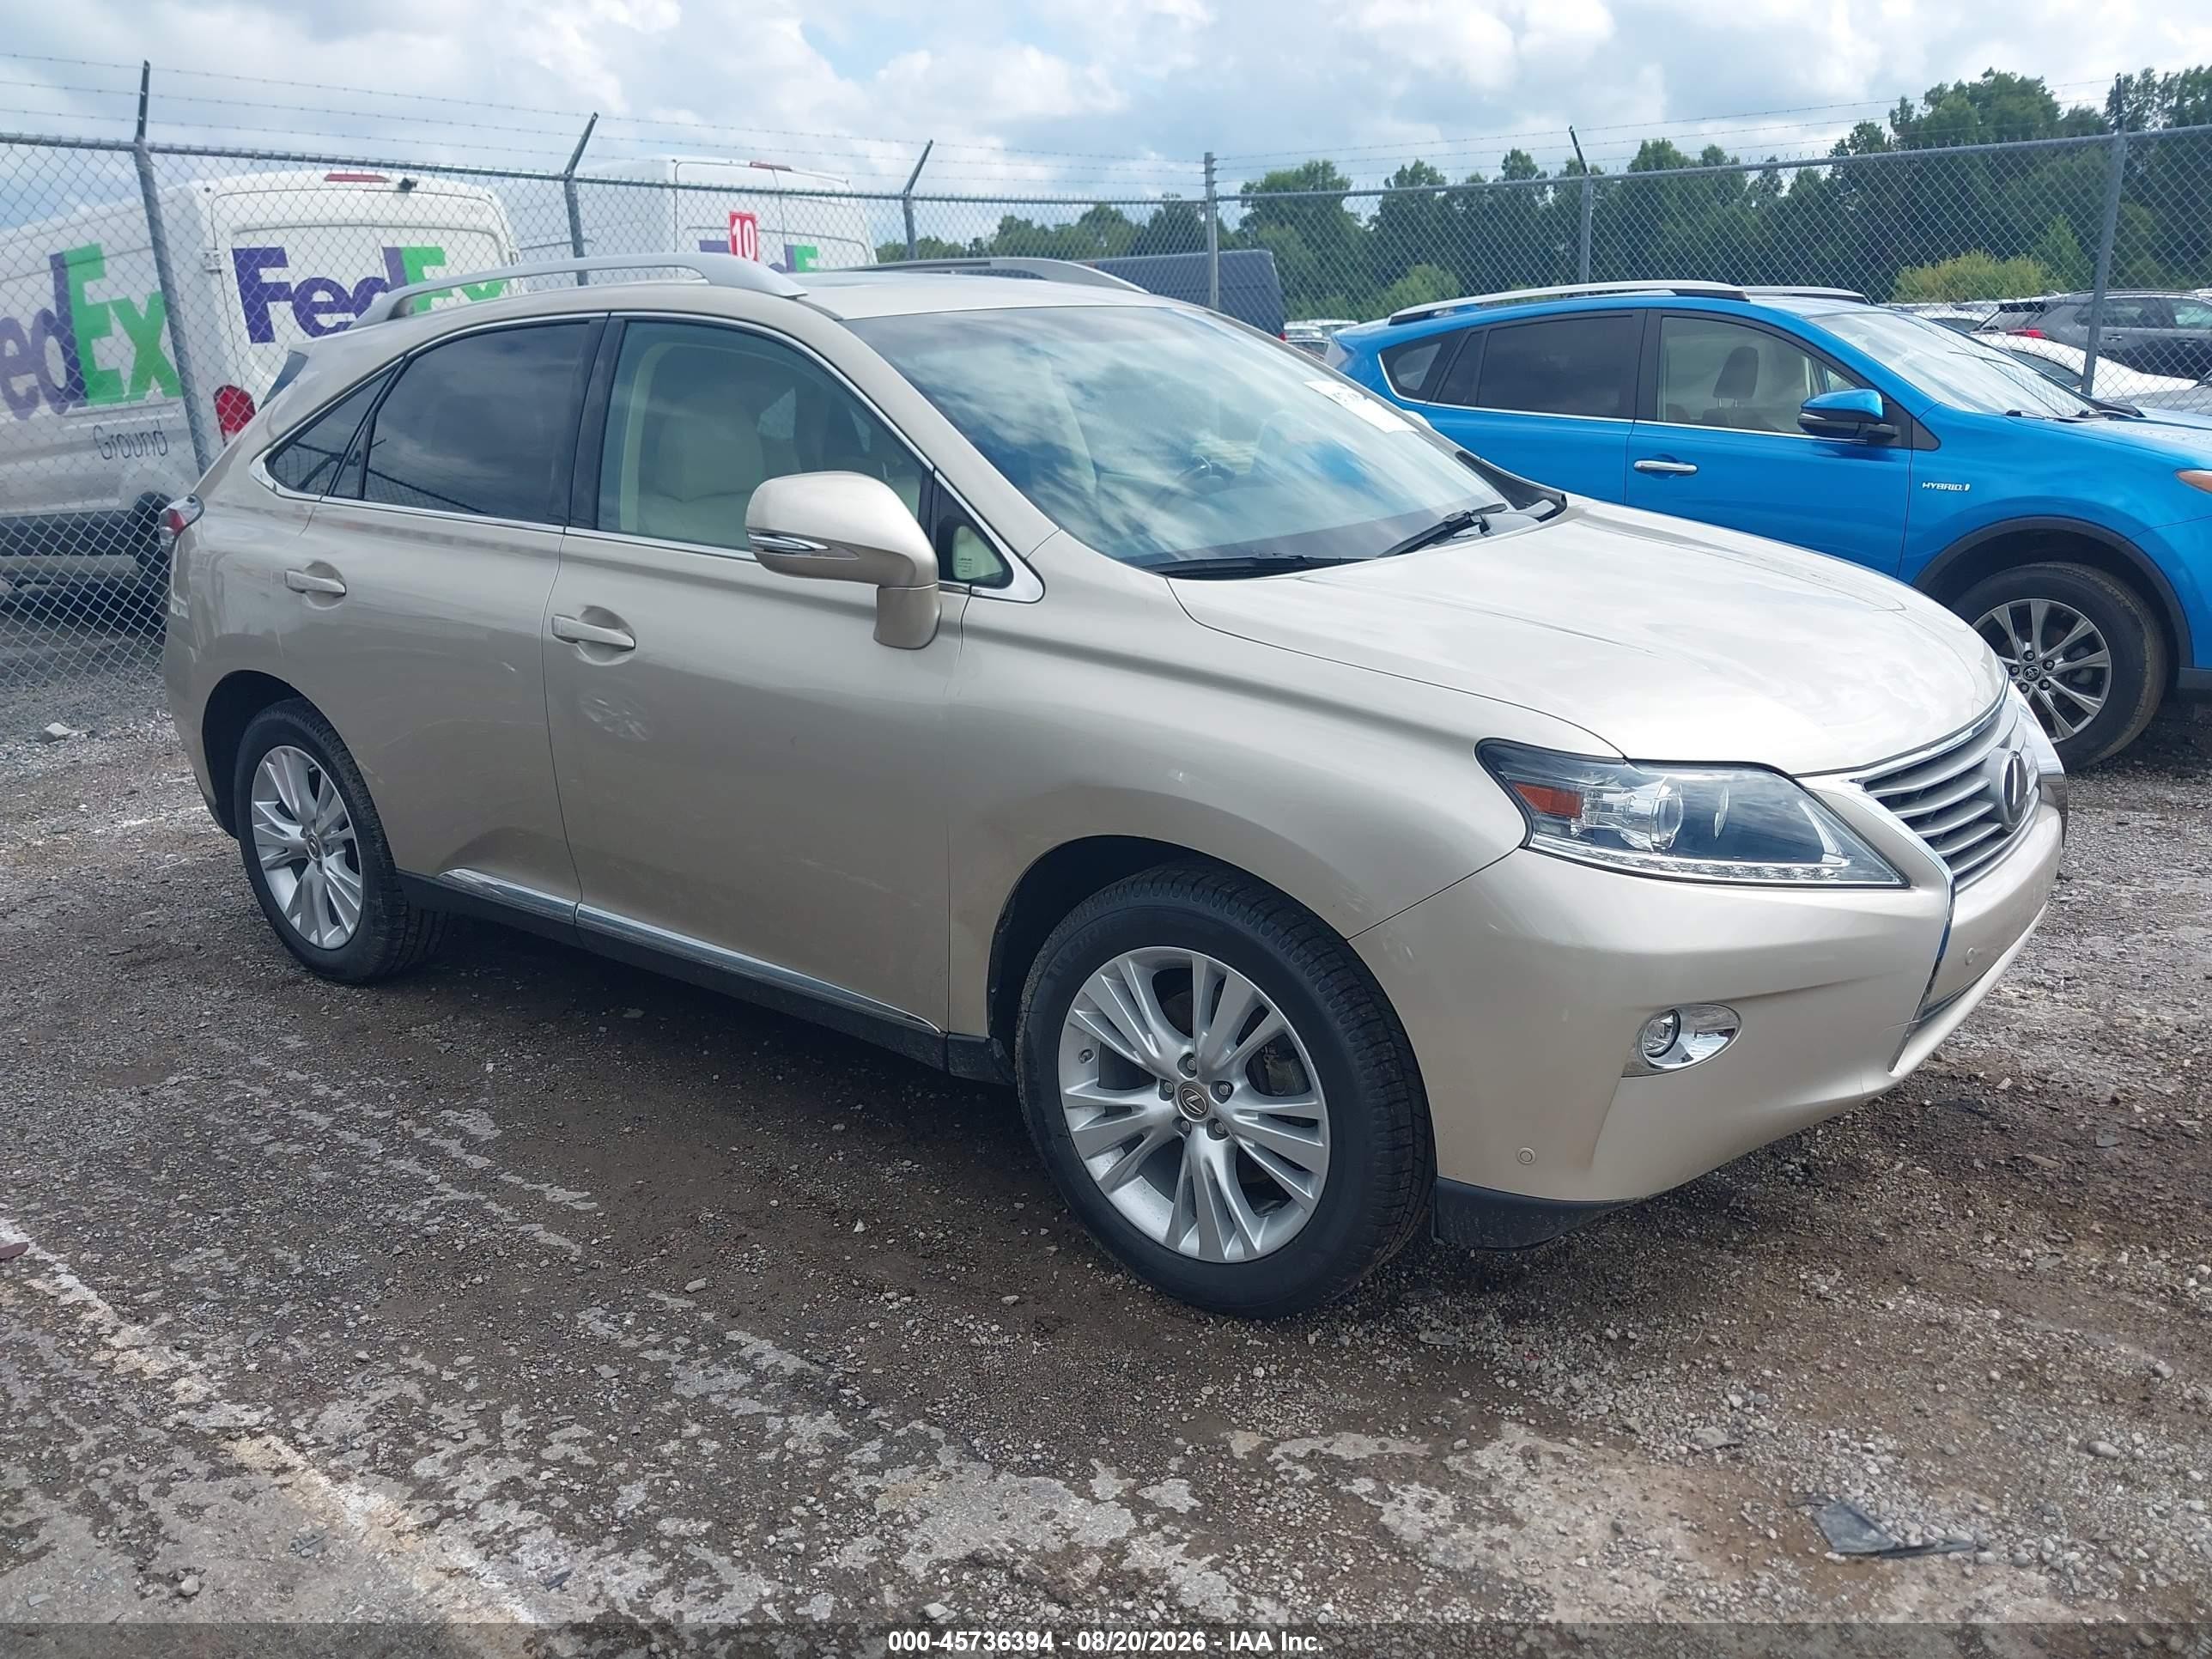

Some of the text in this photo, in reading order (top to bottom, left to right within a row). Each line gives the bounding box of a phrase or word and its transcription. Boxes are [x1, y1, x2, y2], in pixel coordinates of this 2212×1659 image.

[732, 218, 757, 261] 10
[0, 243, 183, 421] edEx
[93, 419, 168, 460] Ground
[1922, 482, 1963, 491] HYBRID
